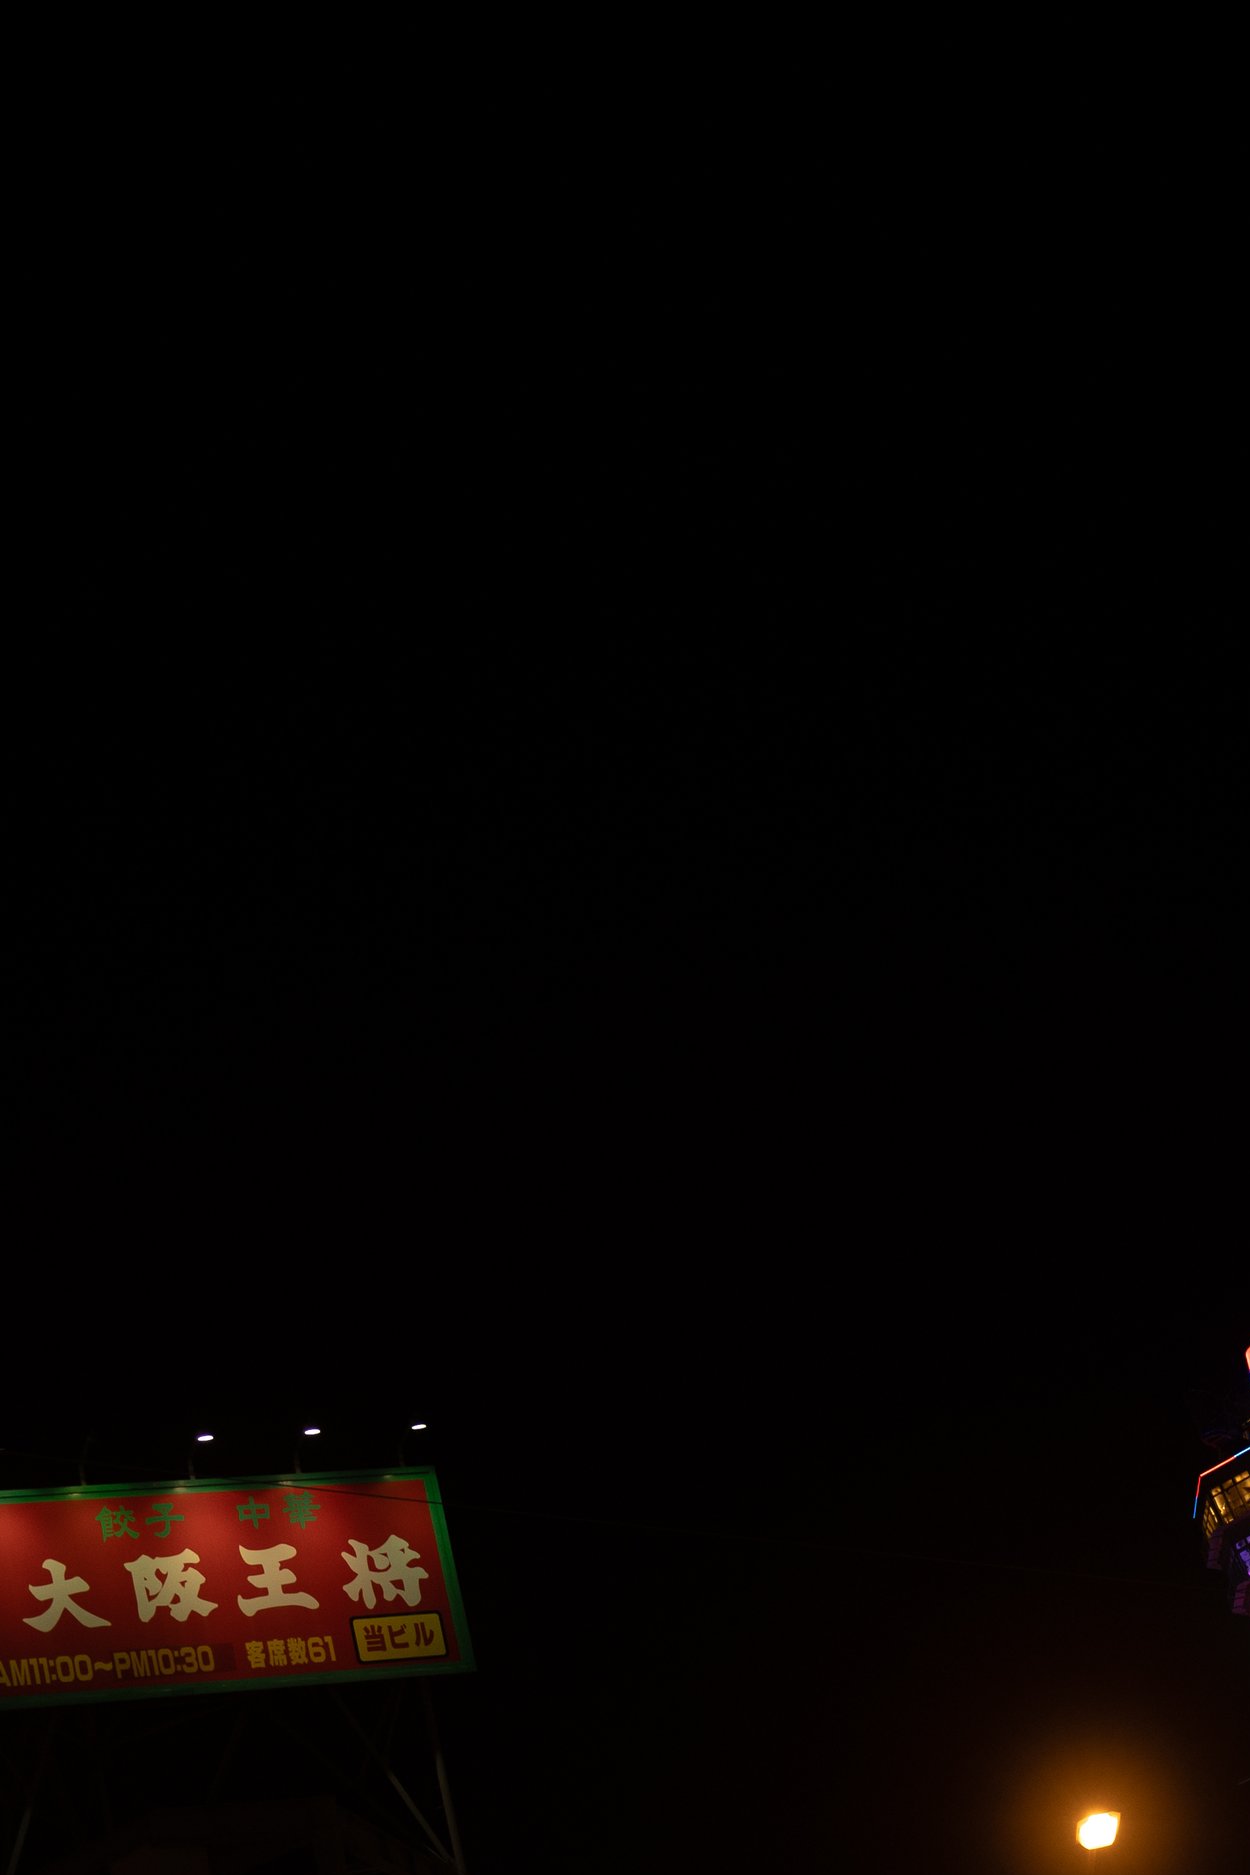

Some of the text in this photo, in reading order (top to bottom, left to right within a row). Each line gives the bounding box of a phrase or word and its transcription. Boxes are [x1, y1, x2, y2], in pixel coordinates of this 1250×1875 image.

[95, 1491, 321, 1542] 餃子 中華
[22, 1534, 429, 1633] 大阪王将
[246, 1635, 336, 1669] 客席数61
[363, 1622, 435, 1654] 当ビル
